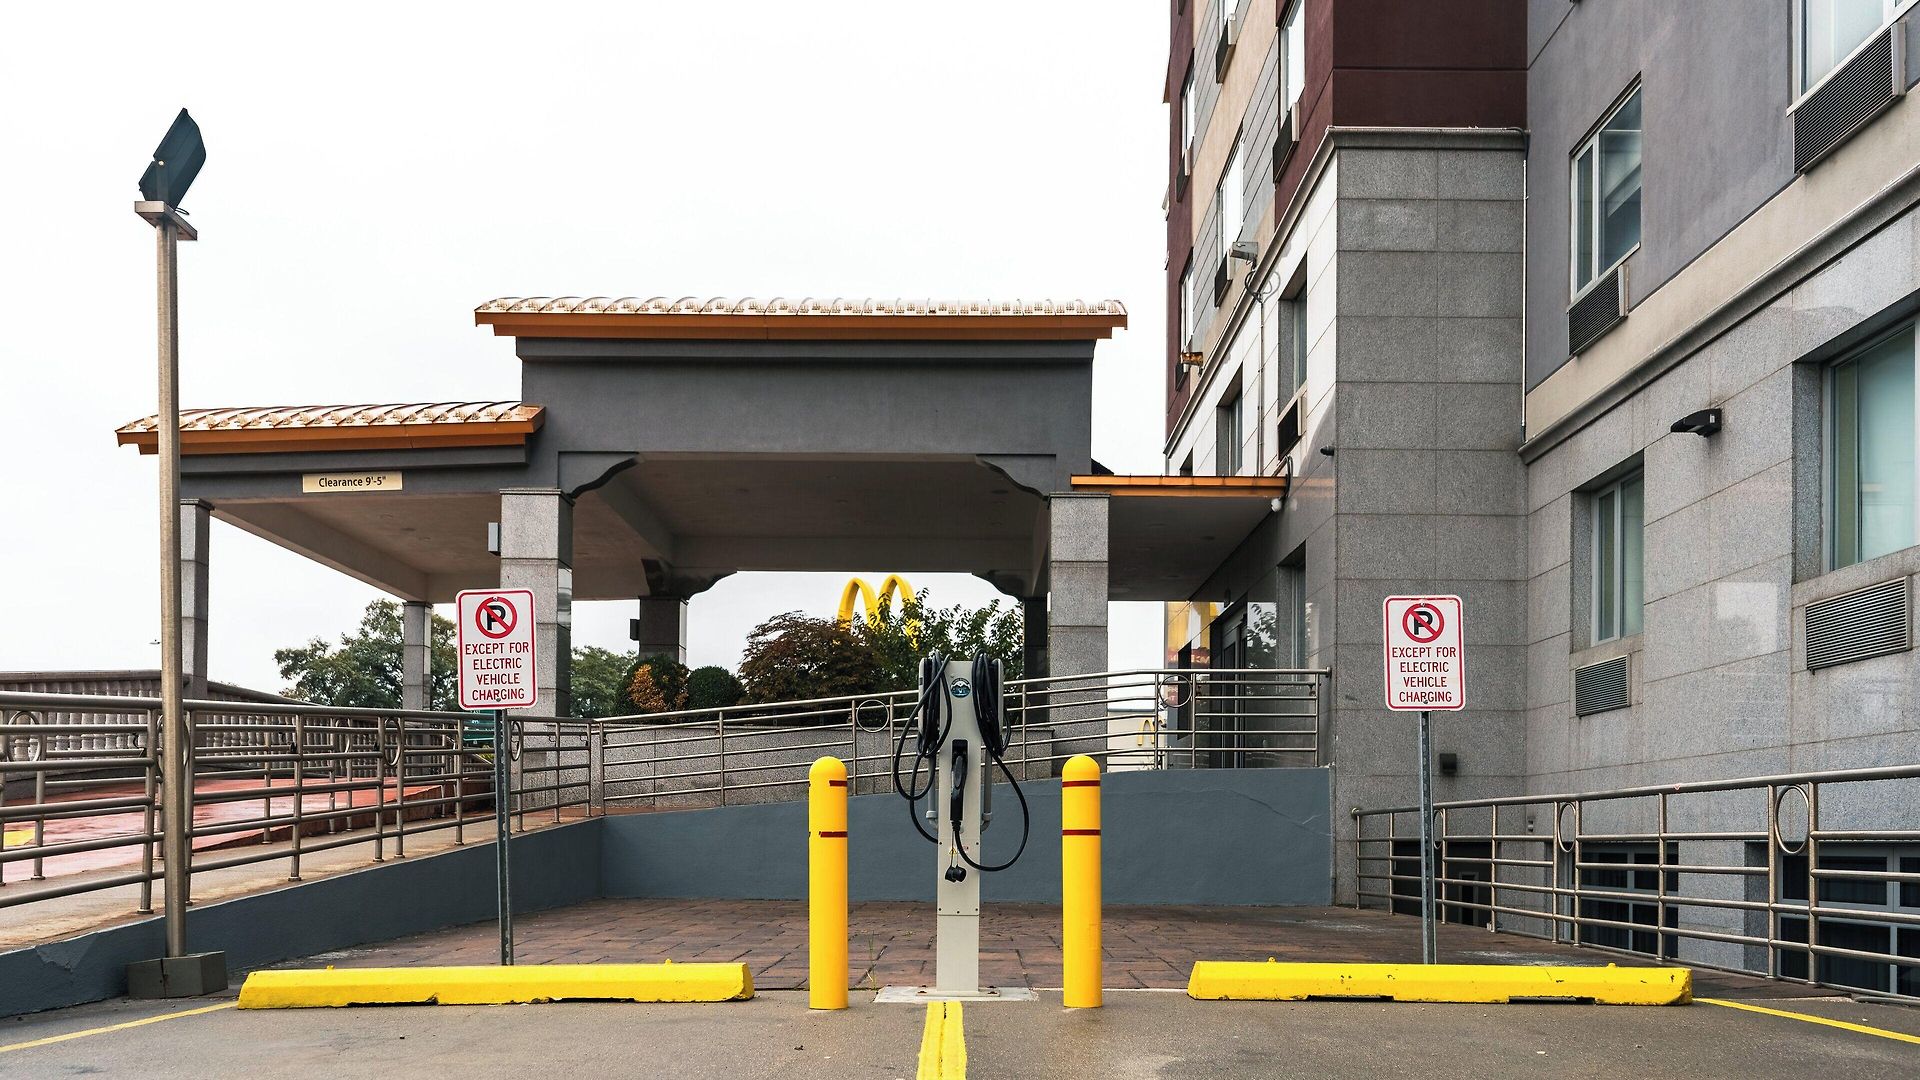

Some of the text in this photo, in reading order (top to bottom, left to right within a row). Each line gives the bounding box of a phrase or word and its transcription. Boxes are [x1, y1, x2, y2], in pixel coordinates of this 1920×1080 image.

[318, 475, 387, 488] Clearance 9'-5"
[465, 641, 530, 655] EXCEPT FOR
[1391, 646, 1457, 658] EXCEPT FOR
[473, 657, 523, 670] ELECTRIC
[1399, 661, 1450, 673] ELECTRIC
[476, 672, 521, 685] VEHICLE
[1403, 676, 1448, 688] VEHICLE
[472, 687, 525, 701] CHARGING
[1398, 691, 1453, 703] CHARGING
